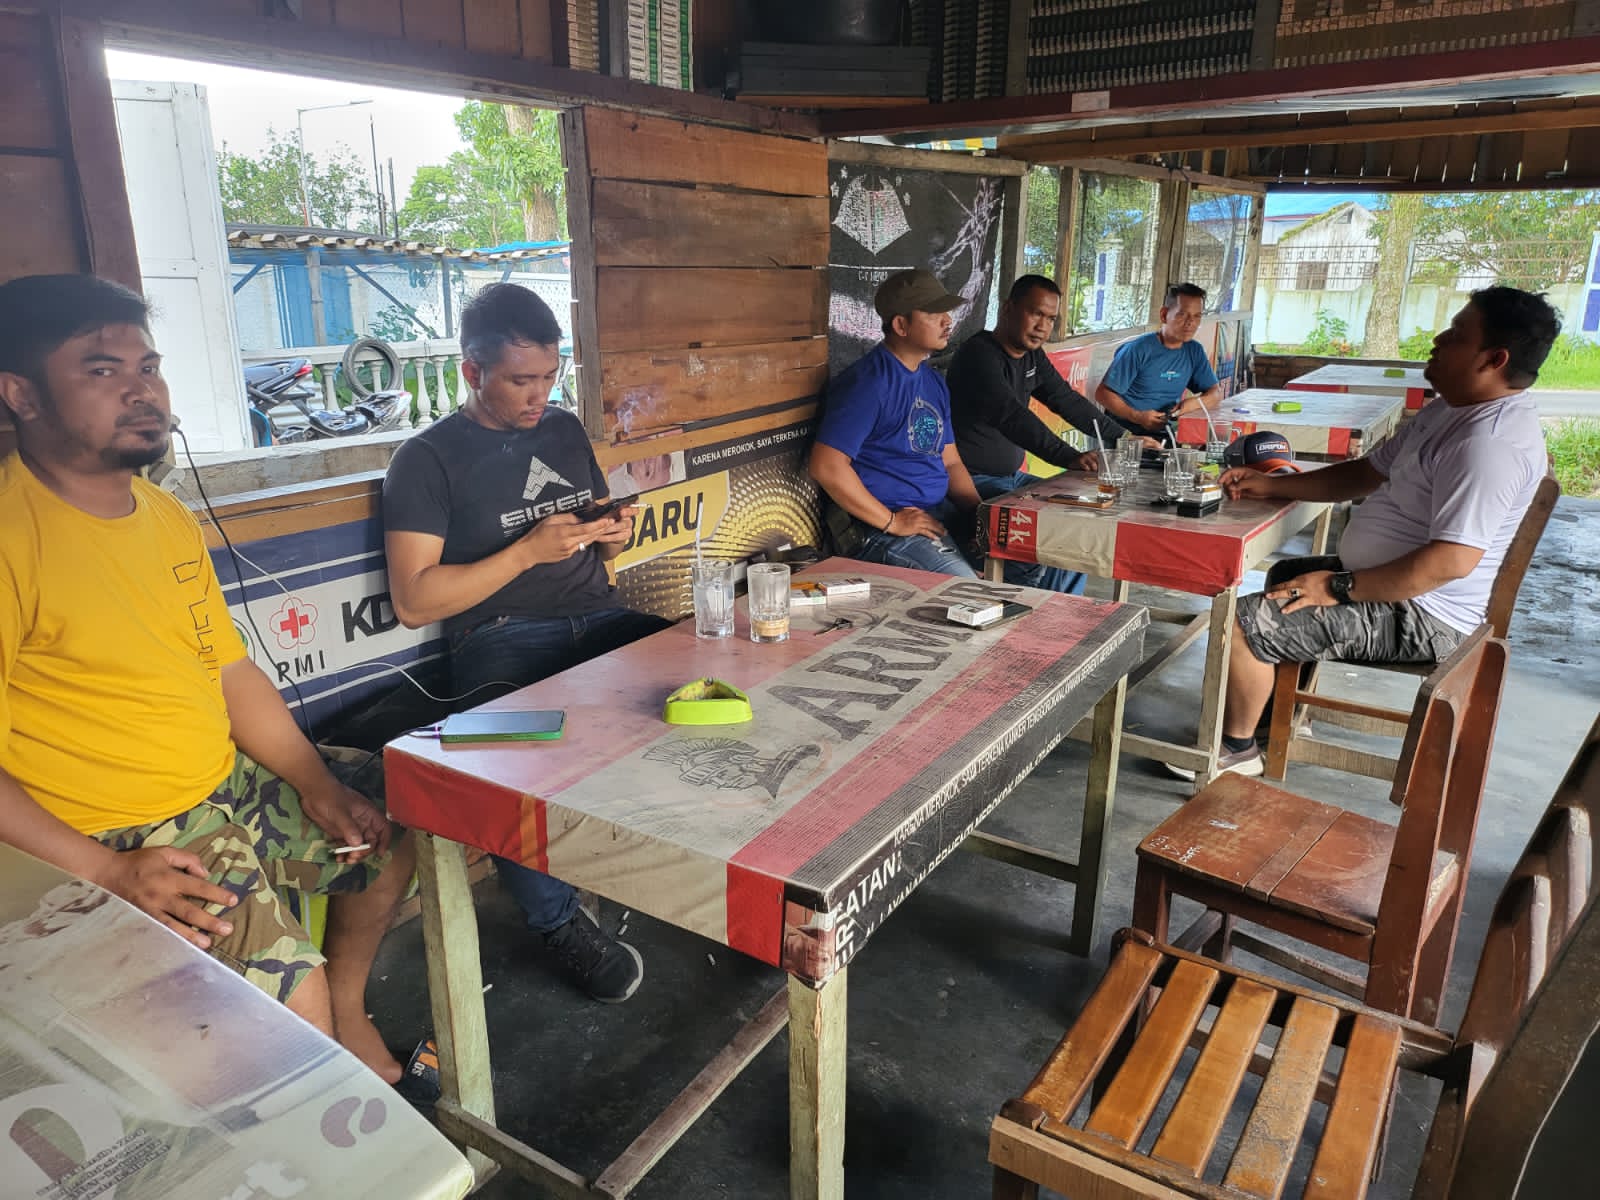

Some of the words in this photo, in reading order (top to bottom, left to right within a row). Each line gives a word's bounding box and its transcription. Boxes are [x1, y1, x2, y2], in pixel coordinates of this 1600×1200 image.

[692, 450, 721, 466] KARENA
[756, 436, 772, 450] SAYA
[499, 488, 594, 529] EIGER
